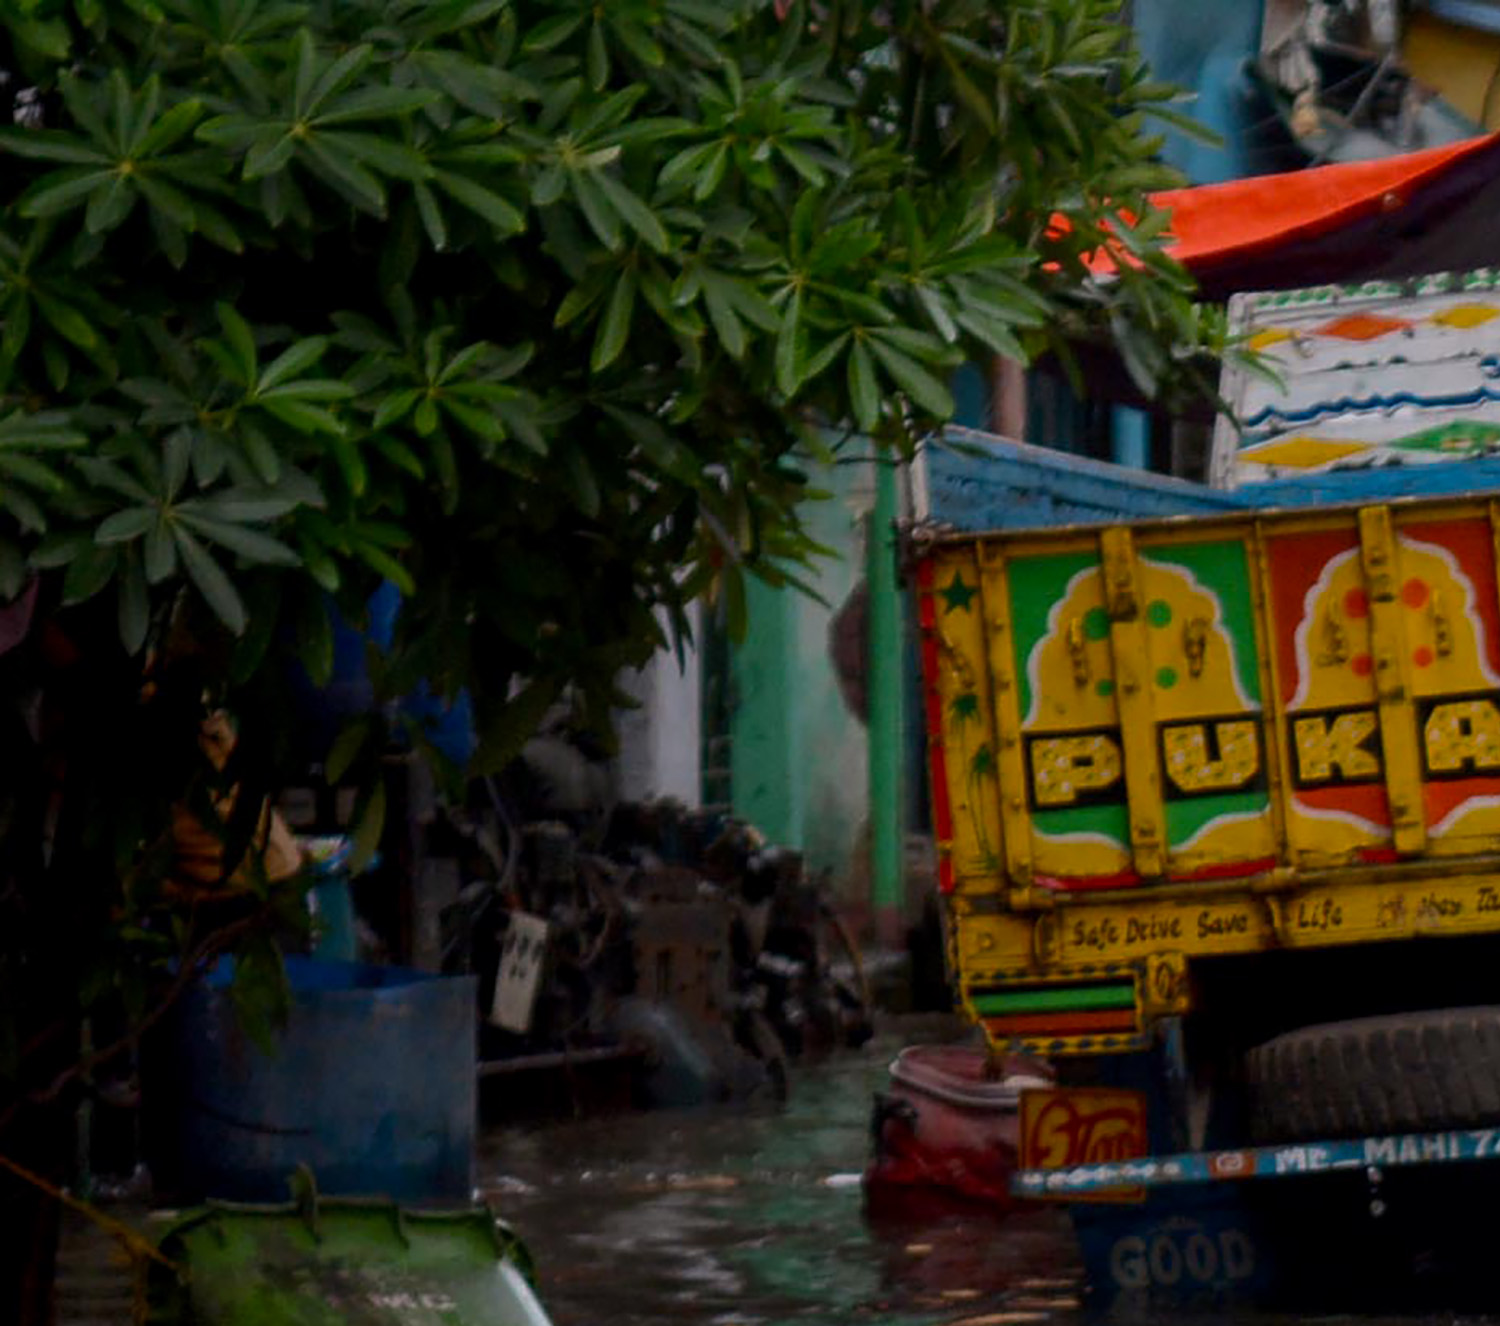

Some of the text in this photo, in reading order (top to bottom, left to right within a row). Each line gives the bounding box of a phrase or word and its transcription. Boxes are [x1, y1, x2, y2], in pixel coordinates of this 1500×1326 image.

[1072, 916, 1118, 952] Safe
[1126, 910, 1182, 943] Drive
[1197, 907, 1248, 940] Save
[1299, 898, 1343, 931] Life
[1110, 1228, 1256, 1290] GOOD
